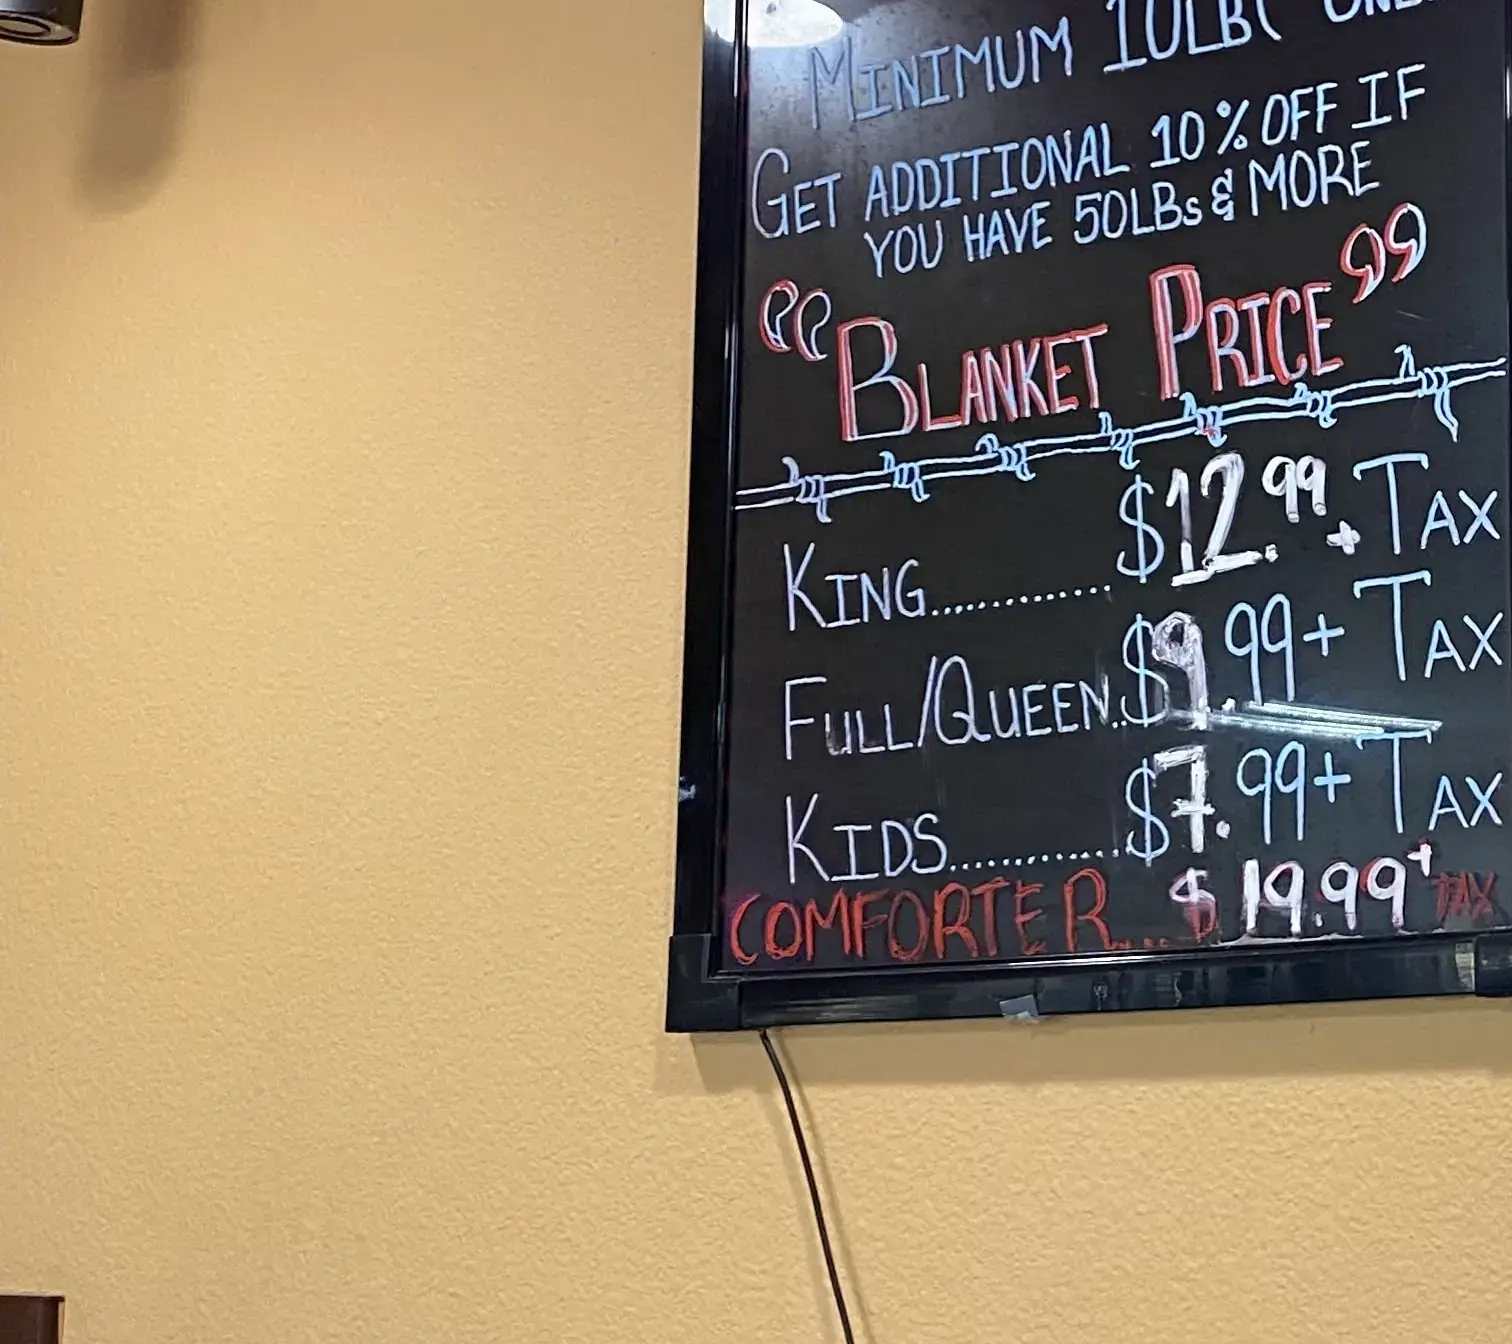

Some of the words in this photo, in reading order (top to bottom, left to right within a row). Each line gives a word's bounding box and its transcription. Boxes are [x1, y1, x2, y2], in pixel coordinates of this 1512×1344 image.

[808, 16, 1074, 130] MINIMUM
[752, 148, 841, 239] GET
[864, 124, 1130, 222] ADDITIONAL
[1261, 82, 1338, 144] OFF
[1352, 64, 1428, 131] IF
[864, 223, 943, 279] YOU
[965, 203, 1053, 267] HAVE
[1212, 176, 1236, 221] &
[1251, 140, 1380, 216] MORE
[1352, 453, 1500, 556] TAX
[1352, 570, 1504, 682] TAX
[1356, 728, 1503, 836] TAX
[1431, 873, 1500, 922] TAX
